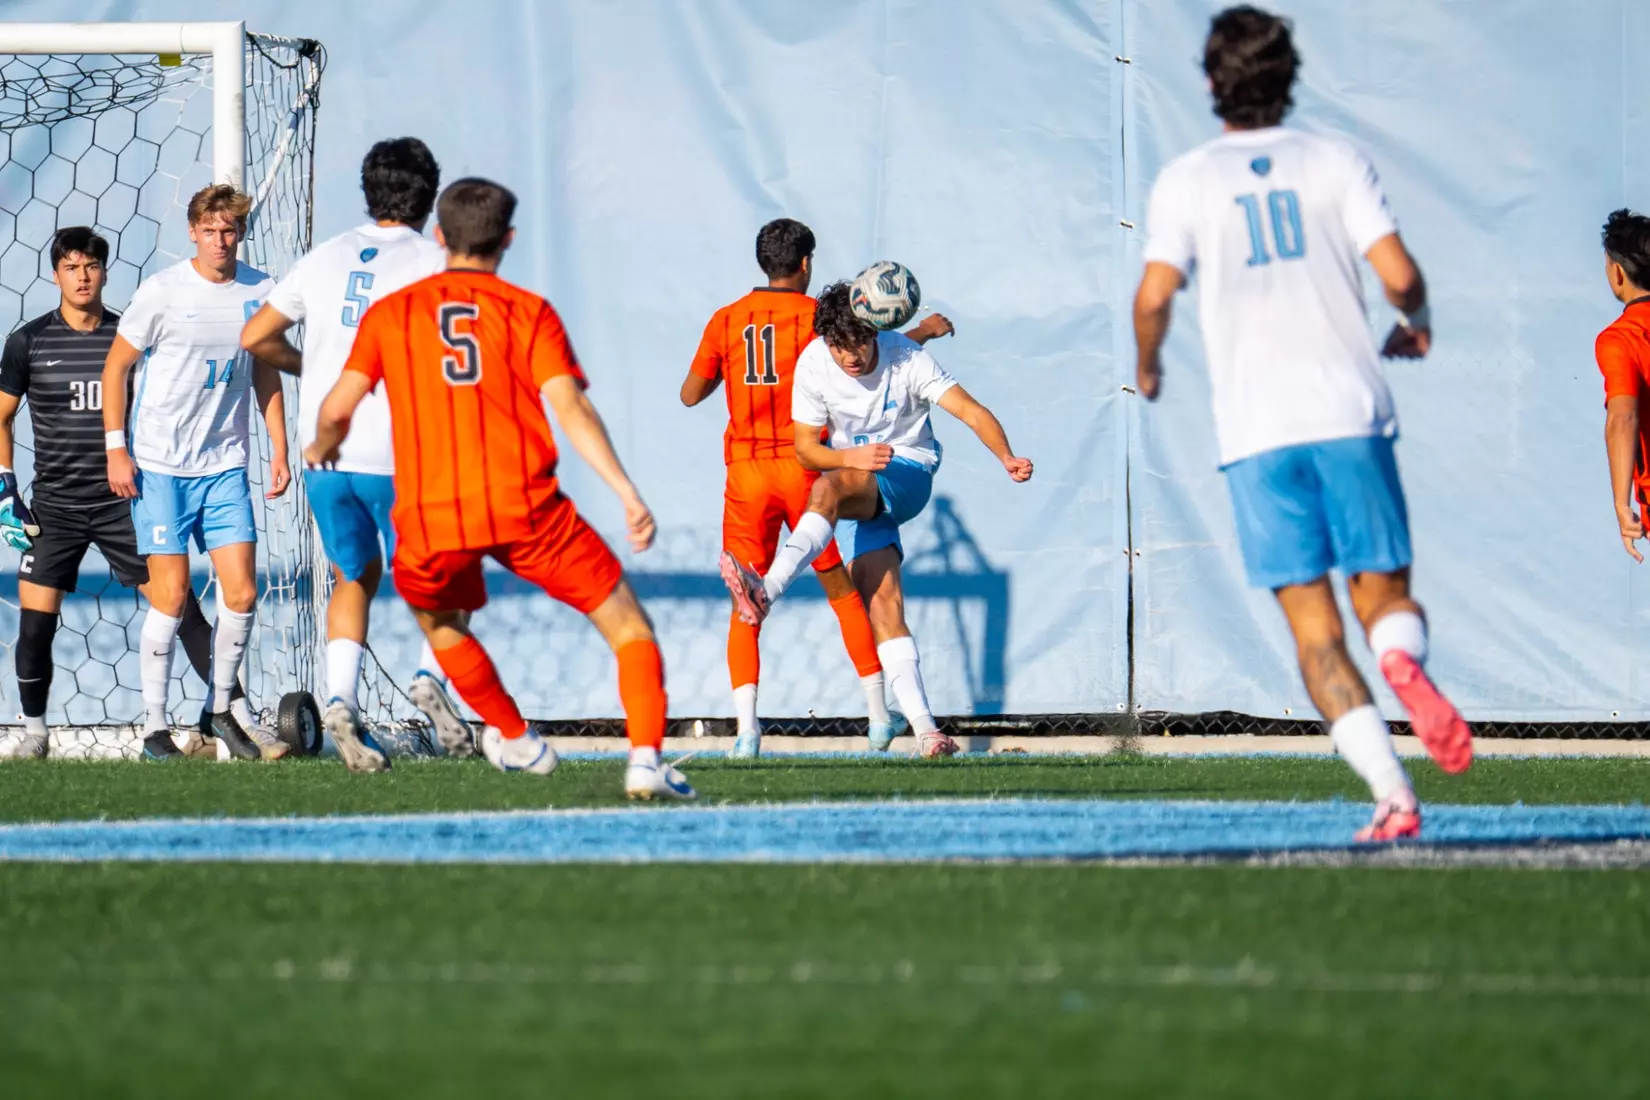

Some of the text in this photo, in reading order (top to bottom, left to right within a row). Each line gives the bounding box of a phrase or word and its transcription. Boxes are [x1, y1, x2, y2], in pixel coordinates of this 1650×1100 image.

[1234, 190, 1305, 267] 10
[342, 271, 375, 327] 5
[438, 302, 482, 385] 5
[743, 324, 779, 385] 11
[204, 359, 235, 389] 14
[69, 381, 103, 411] 30
[152, 525, 167, 544] C
[20, 554, 35, 574] C
